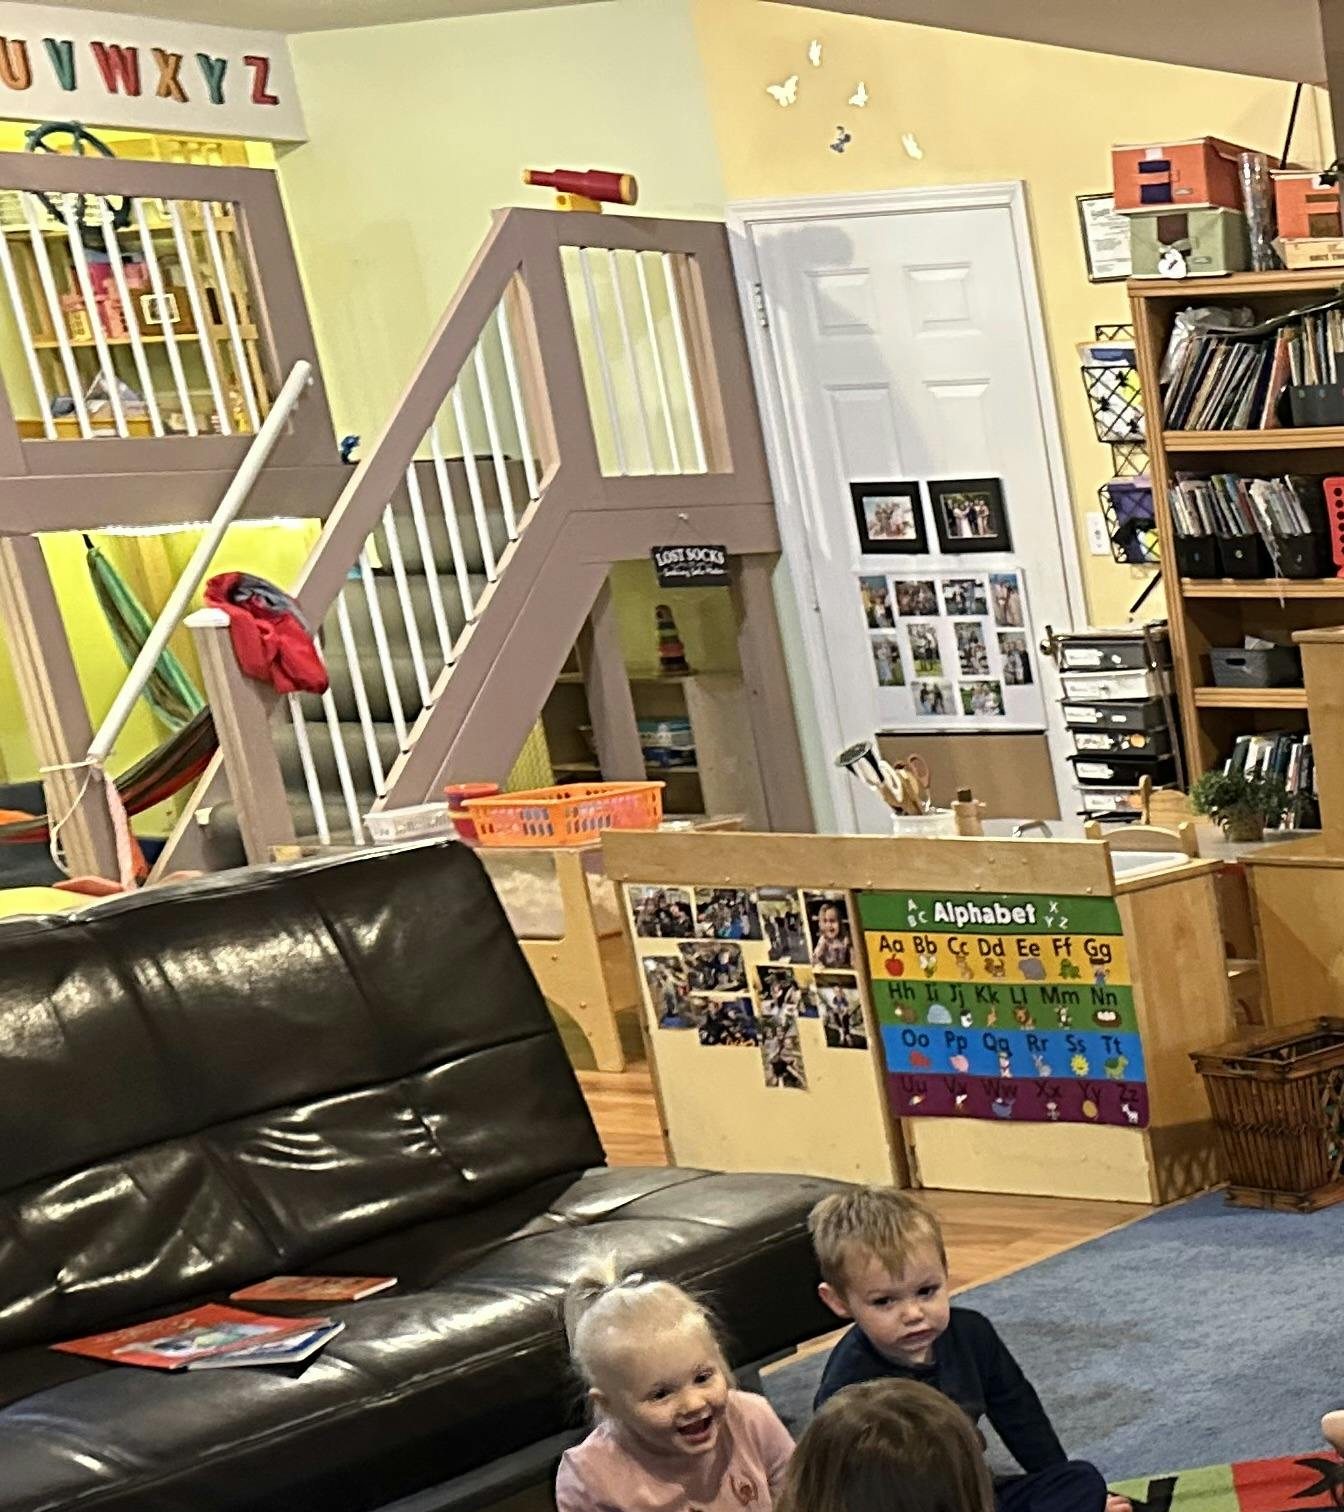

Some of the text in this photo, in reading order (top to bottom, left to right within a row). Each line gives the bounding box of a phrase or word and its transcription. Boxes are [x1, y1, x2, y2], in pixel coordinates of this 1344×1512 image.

[42, 37, 77, 92] V
[90, 41, 141, 97] W
[152, 47, 190, 103] X
[195, 52, 228, 105] Y
[243, 55, 280, 105] Z
[656, 548, 724, 566] LOST SOCKS
[933, 901, 1037, 928] Alphabet
[879, 934, 1113, 963] Aa Bb Cc Dd Ee Ff Gg
[888, 982, 916, 1001] Hh
[974, 985, 1001, 1004] Kk
[1040, 987, 1080, 1006] Mm
[1090, 987, 1118, 1006] Nn
[901, 1029, 930, 1048] Oo
[944, 1030, 968, 1054] Pp
[1026, 1034, 1050, 1053] Rr
[1064, 1034, 1087, 1053] Ss
[1101, 1035, 1123, 1055] Tt
